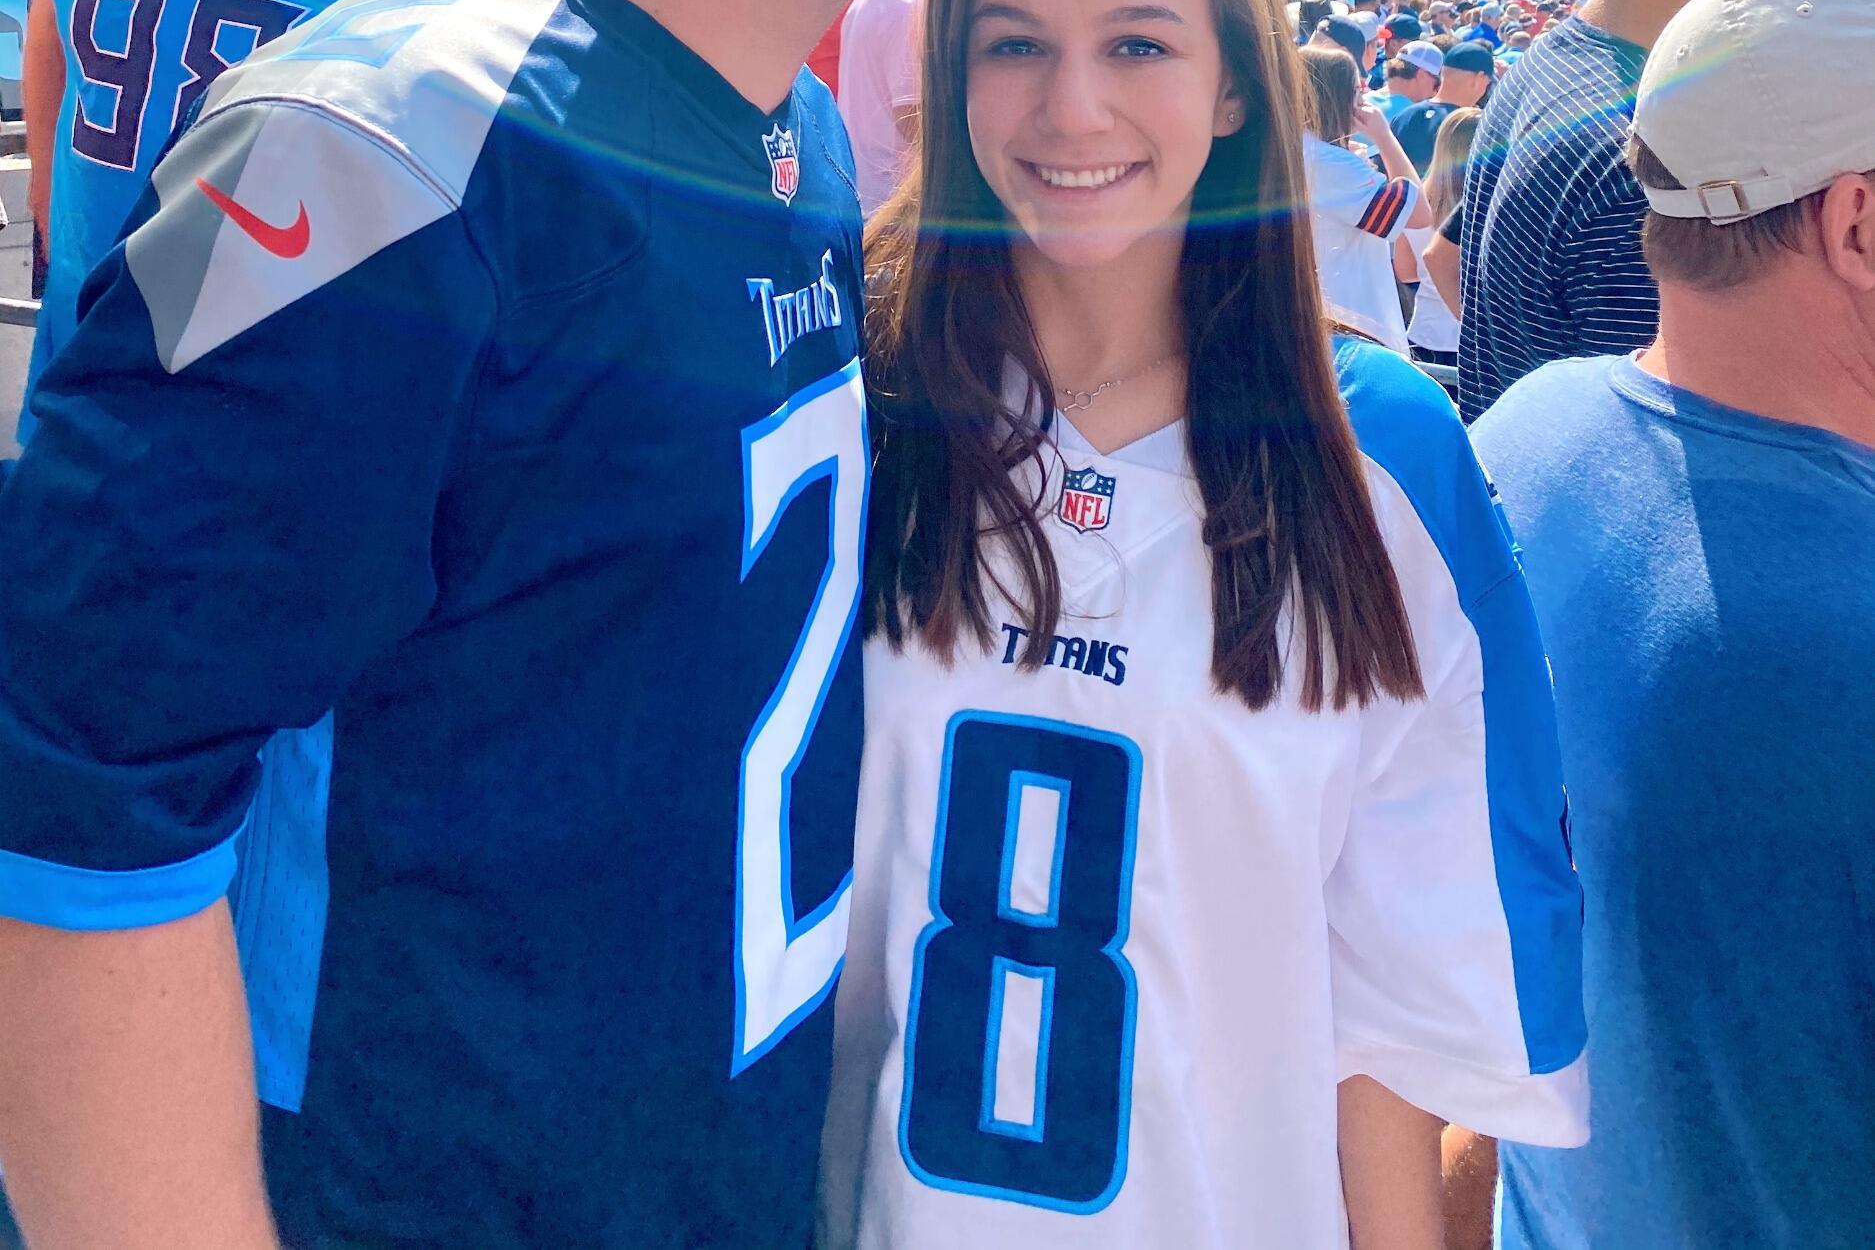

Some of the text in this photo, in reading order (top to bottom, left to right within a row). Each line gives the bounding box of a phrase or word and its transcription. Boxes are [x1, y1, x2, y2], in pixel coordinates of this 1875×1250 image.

[1062, 490, 1106, 527] NFL
[1001, 622, 1129, 687] TTANS
[897, 707, 1144, 1217] 8
